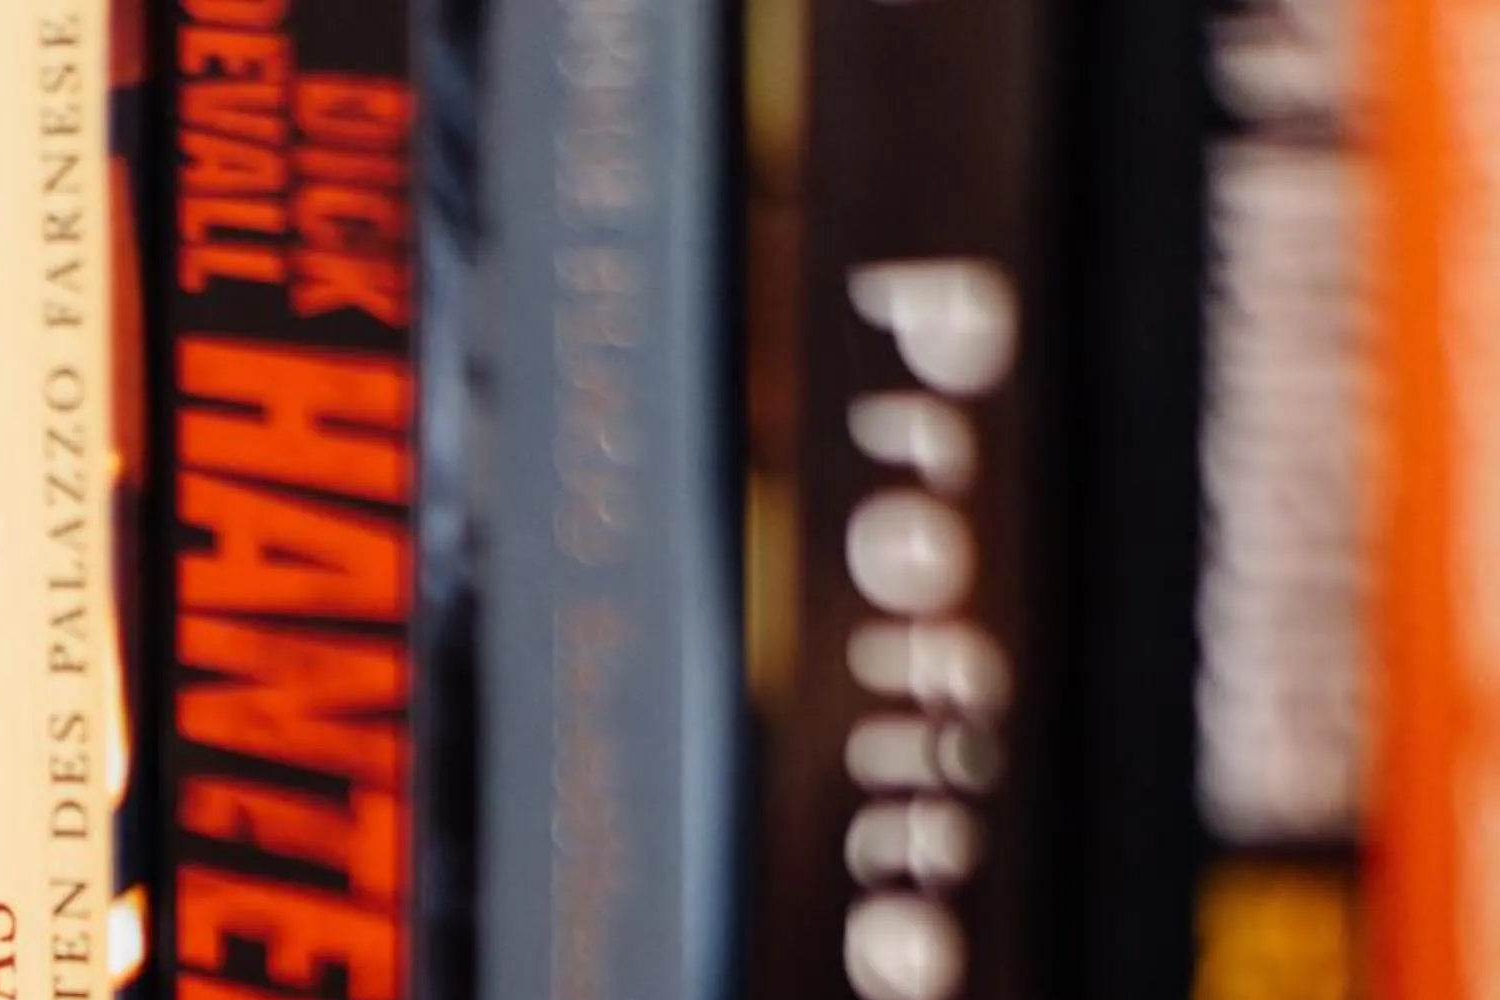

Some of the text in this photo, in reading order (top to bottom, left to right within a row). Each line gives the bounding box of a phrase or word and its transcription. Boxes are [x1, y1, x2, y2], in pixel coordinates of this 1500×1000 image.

[39, 14, 84, 329] FARNESE
[292, 73, 417, 328] DICK
[45, 364, 88, 675] PALAZZO
[49, 711, 89, 840] DES
